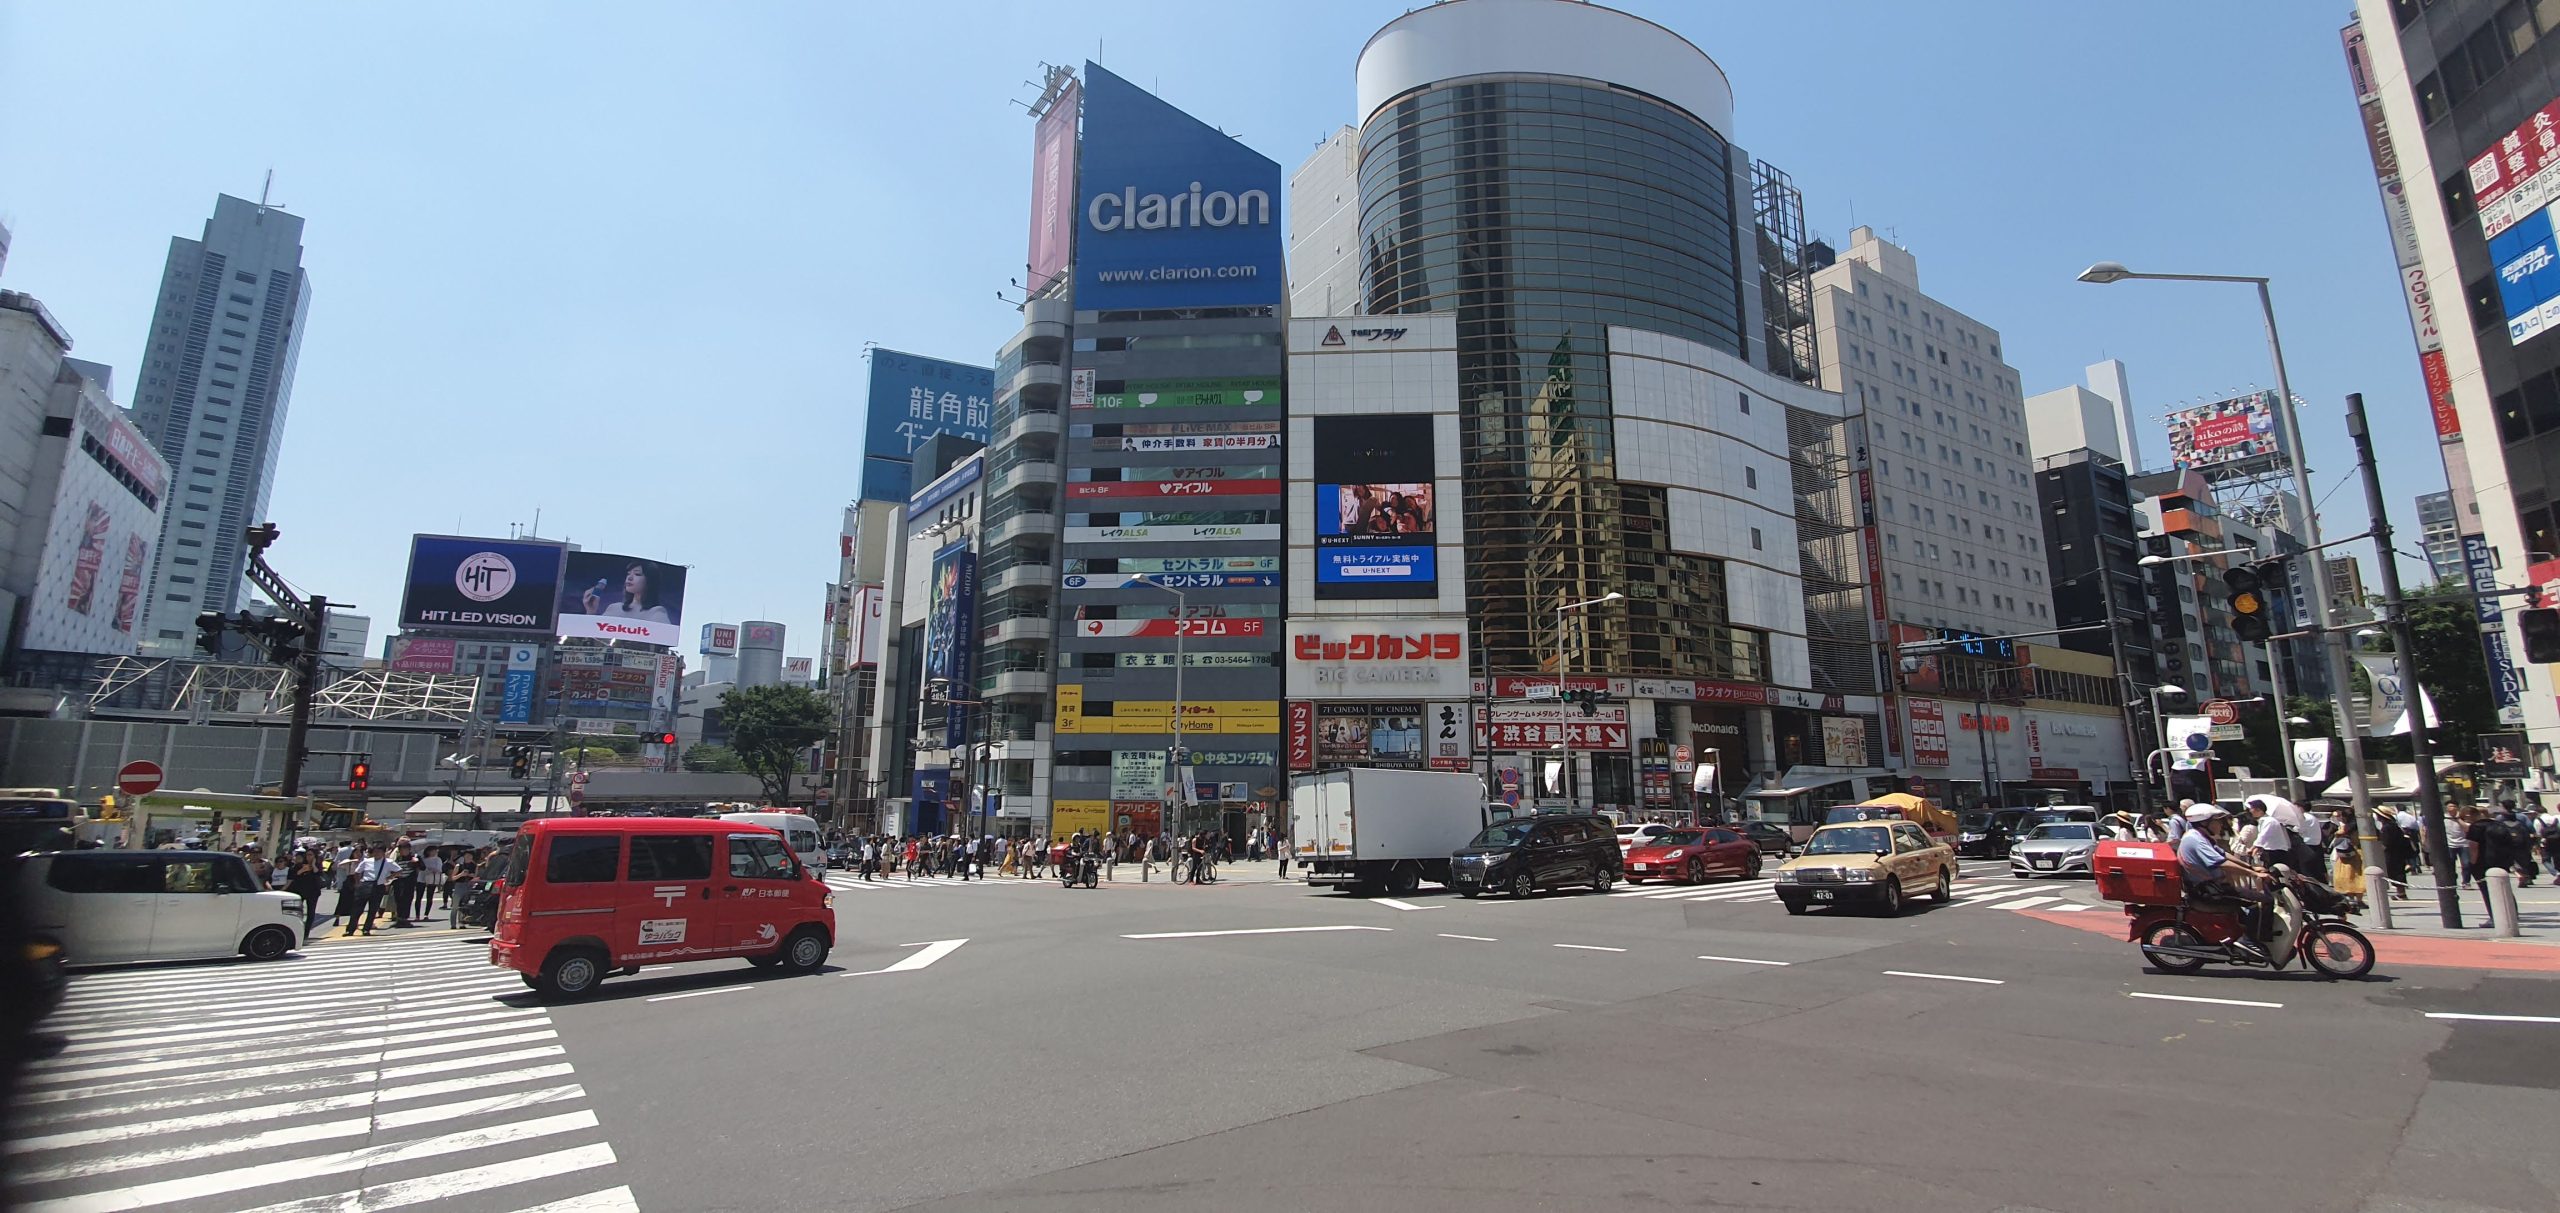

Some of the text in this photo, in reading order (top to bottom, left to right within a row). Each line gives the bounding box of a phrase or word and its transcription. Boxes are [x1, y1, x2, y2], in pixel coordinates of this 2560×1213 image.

[1088, 181, 1270, 232] clarion
[1098, 264, 1257, 282] www.clarion.com
[909, 386, 990, 429] 龍角散
[1103, 396, 1123, 408] 10F
[1142, 436, 1267, 449] 仲介手数料 家賃の半月分
[1185, 467, 1225, 479] アイフル
[1172, 482, 1213, 494] アイフル
[1101, 527, 1242, 538] レイクALSA レイクALSA
[1162, 558, 1224, 571] セントラル
[1332, 554, 1420, 564] 無料トライアル実施中
[1068, 576, 1082, 586] 6F
[1162, 575, 1224, 588] セントラル
[420, 609, 537, 626] HIT LED VISION
[596, 622, 650, 636] Yakult
[1174, 620, 1260, 635] アコム 5F
[716, 630, 732, 638] UNI
[716, 639, 733, 647] QLO
[1294, 634, 1461, 660] ビックカメラ
[1125, 654, 1271, 666] 衣笠眼科 03-5464-1788
[1316, 666, 1440, 683] BIC CAMERA
[2500, 660, 2519, 702] SADA
[1615, 683, 1625, 692] 1F
[1697, 686, 1733, 698] カラオケ
[1333, 706, 1366, 714] CINEMA
[1386, 706, 1418, 714] CINEMA
[1061, 719, 1074, 727] 3F
[1691, 722, 1739, 735] McDonald's
[1293, 707, 1307, 761] カラオケ
[1502, 724, 1602, 743] 渋谷最大級
[1204, 752, 1274, 766] 中央コンタクト
[1115, 804, 1161, 813] アプリローン
[758, 889, 790, 898] 日本郵便
[644, 929, 682, 940] ゆうパック
